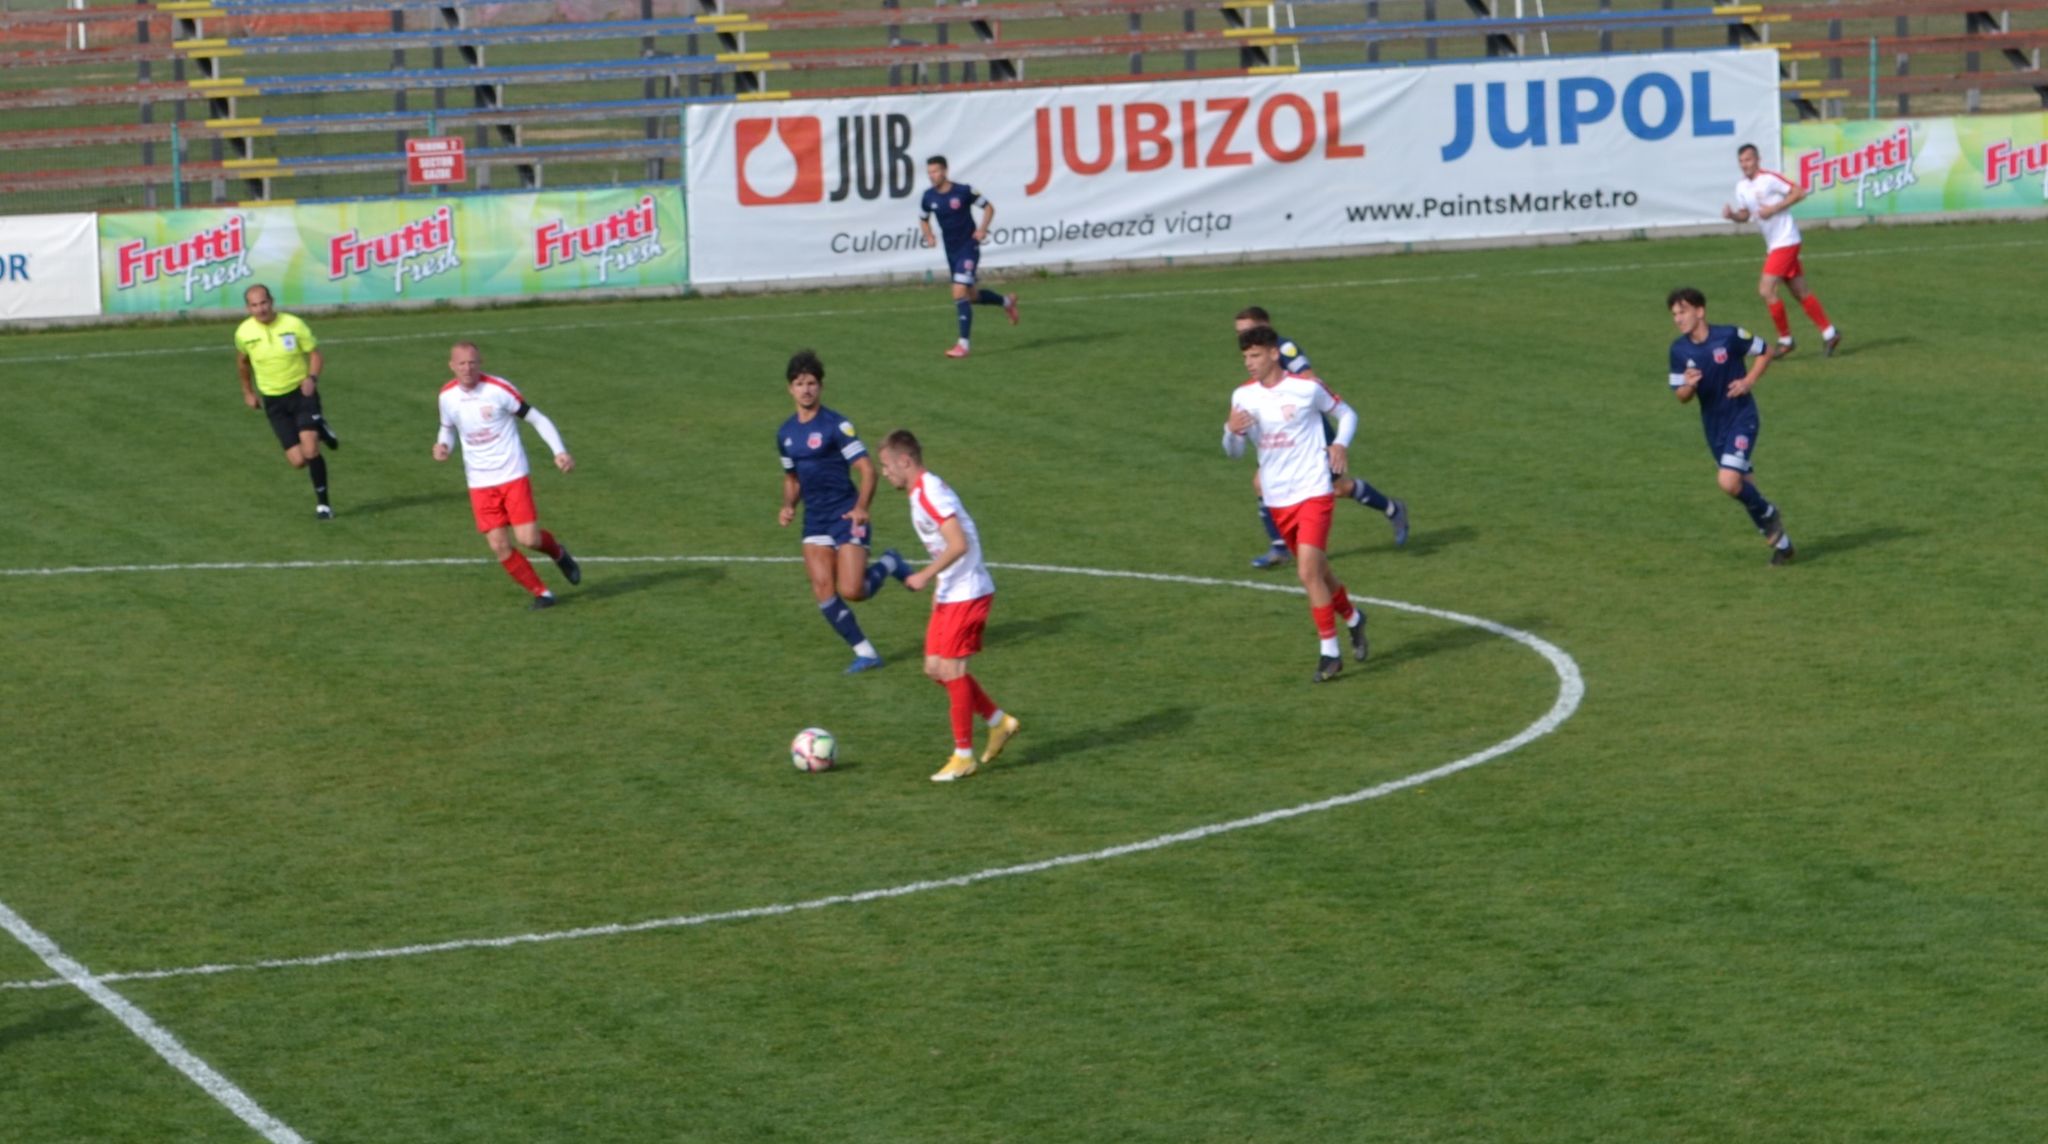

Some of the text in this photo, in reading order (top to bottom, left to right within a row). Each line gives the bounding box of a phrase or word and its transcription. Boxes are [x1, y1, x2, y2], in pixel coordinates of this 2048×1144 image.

[1025, 91, 1365, 196] JUBIZOL
[1441, 70, 1735, 162] JUPOL
[829, 113, 914, 202] JUB
[1799, 126, 1909, 192] Frutti
[536, 196, 656, 269] Frutti
[1346, 189, 1638, 222] www.PaintsMarket.ro
[117, 215, 244, 289] Frutti
[328, 206, 453, 279] Frutti
